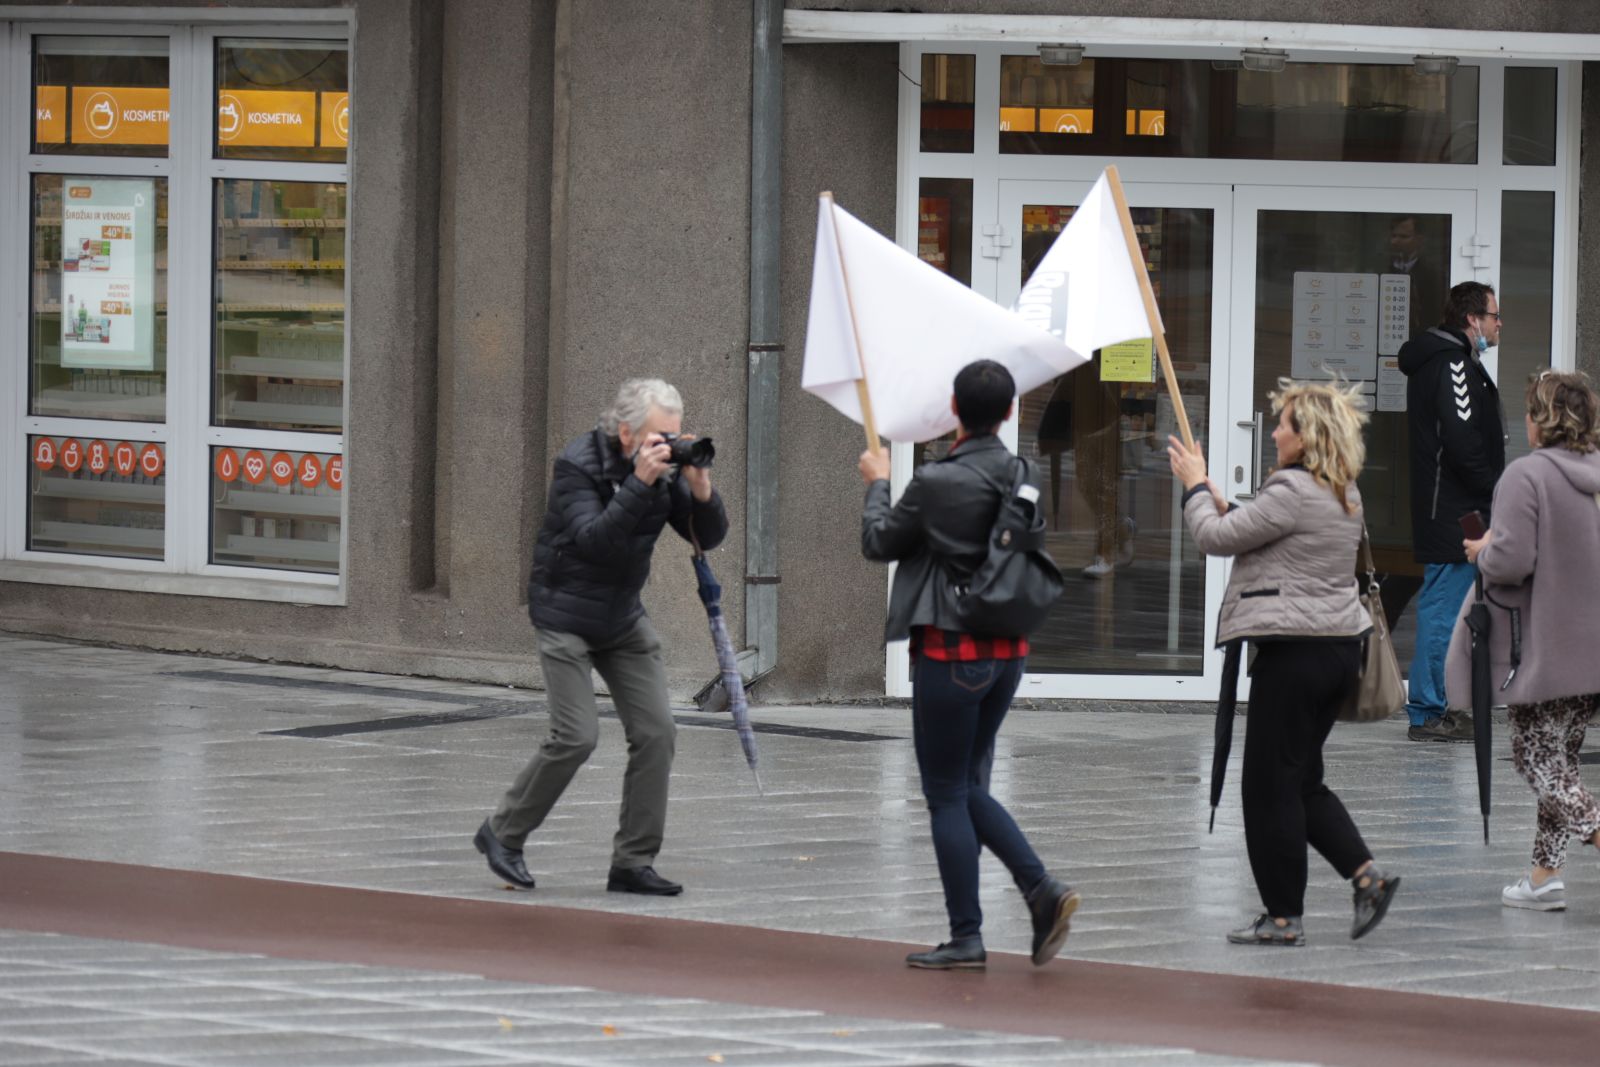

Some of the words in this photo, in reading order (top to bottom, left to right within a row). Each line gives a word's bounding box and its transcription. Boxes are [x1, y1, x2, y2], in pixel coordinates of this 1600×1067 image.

[248, 112, 302, 124] KOSMETIKA
[66, 208, 92, 220] ŠIRDŽIAI
[94, 211, 101, 220] IR
[102, 212, 131, 220] VENOMS
